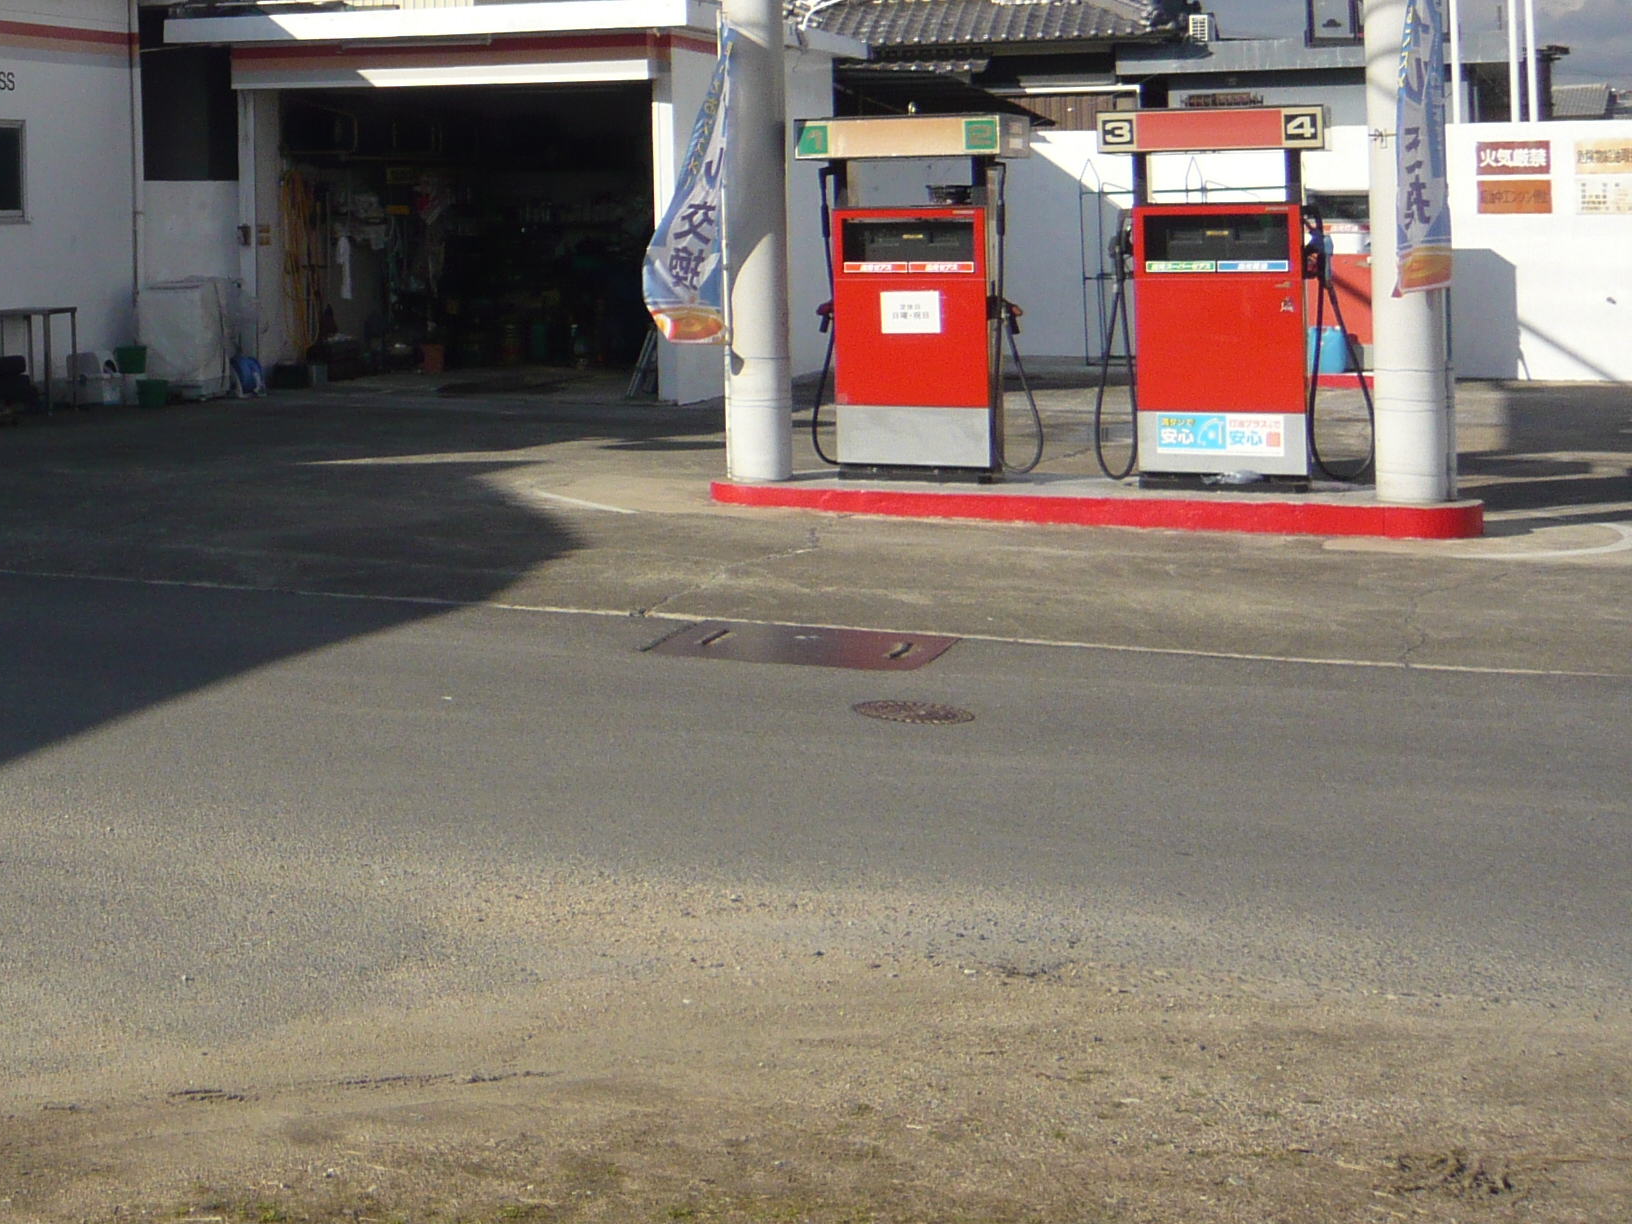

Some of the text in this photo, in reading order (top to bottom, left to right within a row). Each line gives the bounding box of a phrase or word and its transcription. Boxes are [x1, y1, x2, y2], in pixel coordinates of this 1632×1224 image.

[969, 125, 992, 145] 2
[1104, 121, 1131, 143] 3
[1286, 116, 1315, 138] 4
[806, 129, 823, 150] 1
[1480, 148, 1548, 168] 火気厳禁
[1161, 428, 1194, 445] 安心
[1229, 430, 1263, 446] 安心
